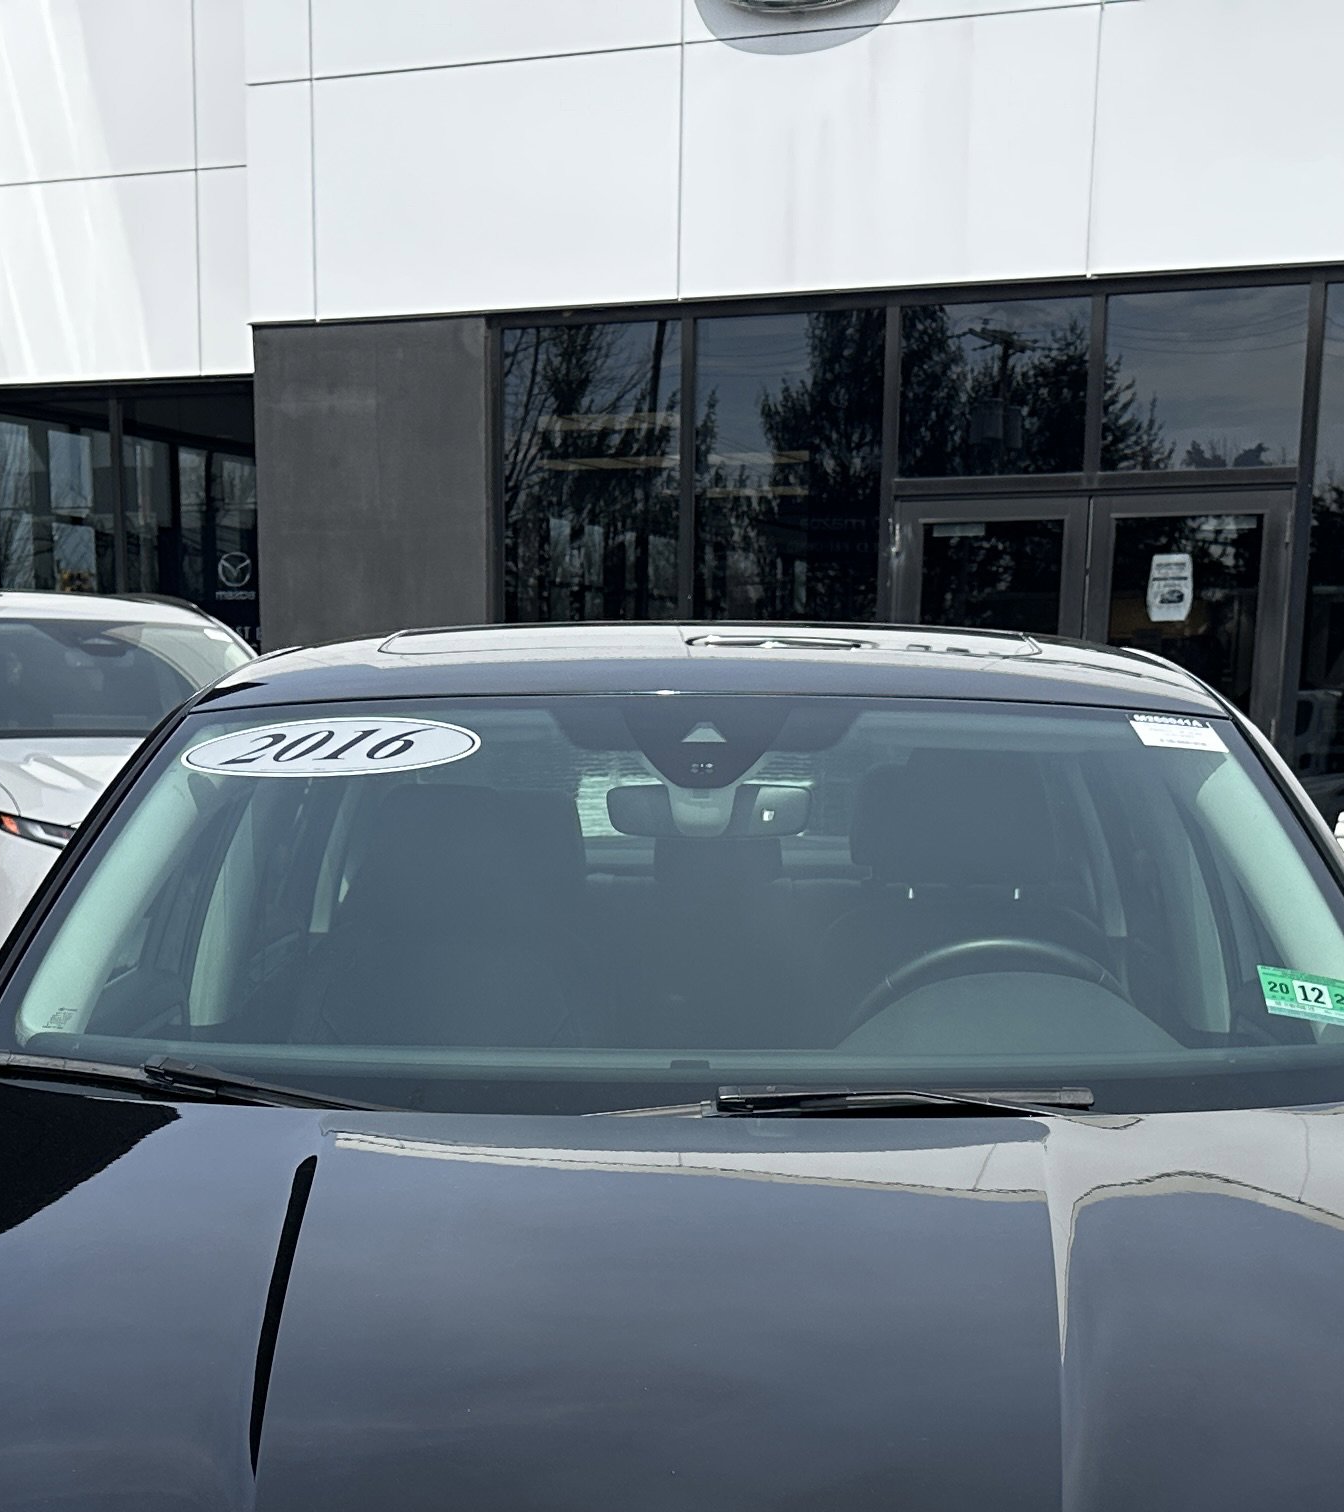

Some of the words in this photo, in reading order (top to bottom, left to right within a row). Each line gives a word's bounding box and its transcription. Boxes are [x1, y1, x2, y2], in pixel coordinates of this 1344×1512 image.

[218, 727, 436, 766] 2016
[1267, 980, 1290, 995] 20
[1297, 985, 1326, 1005] 12
